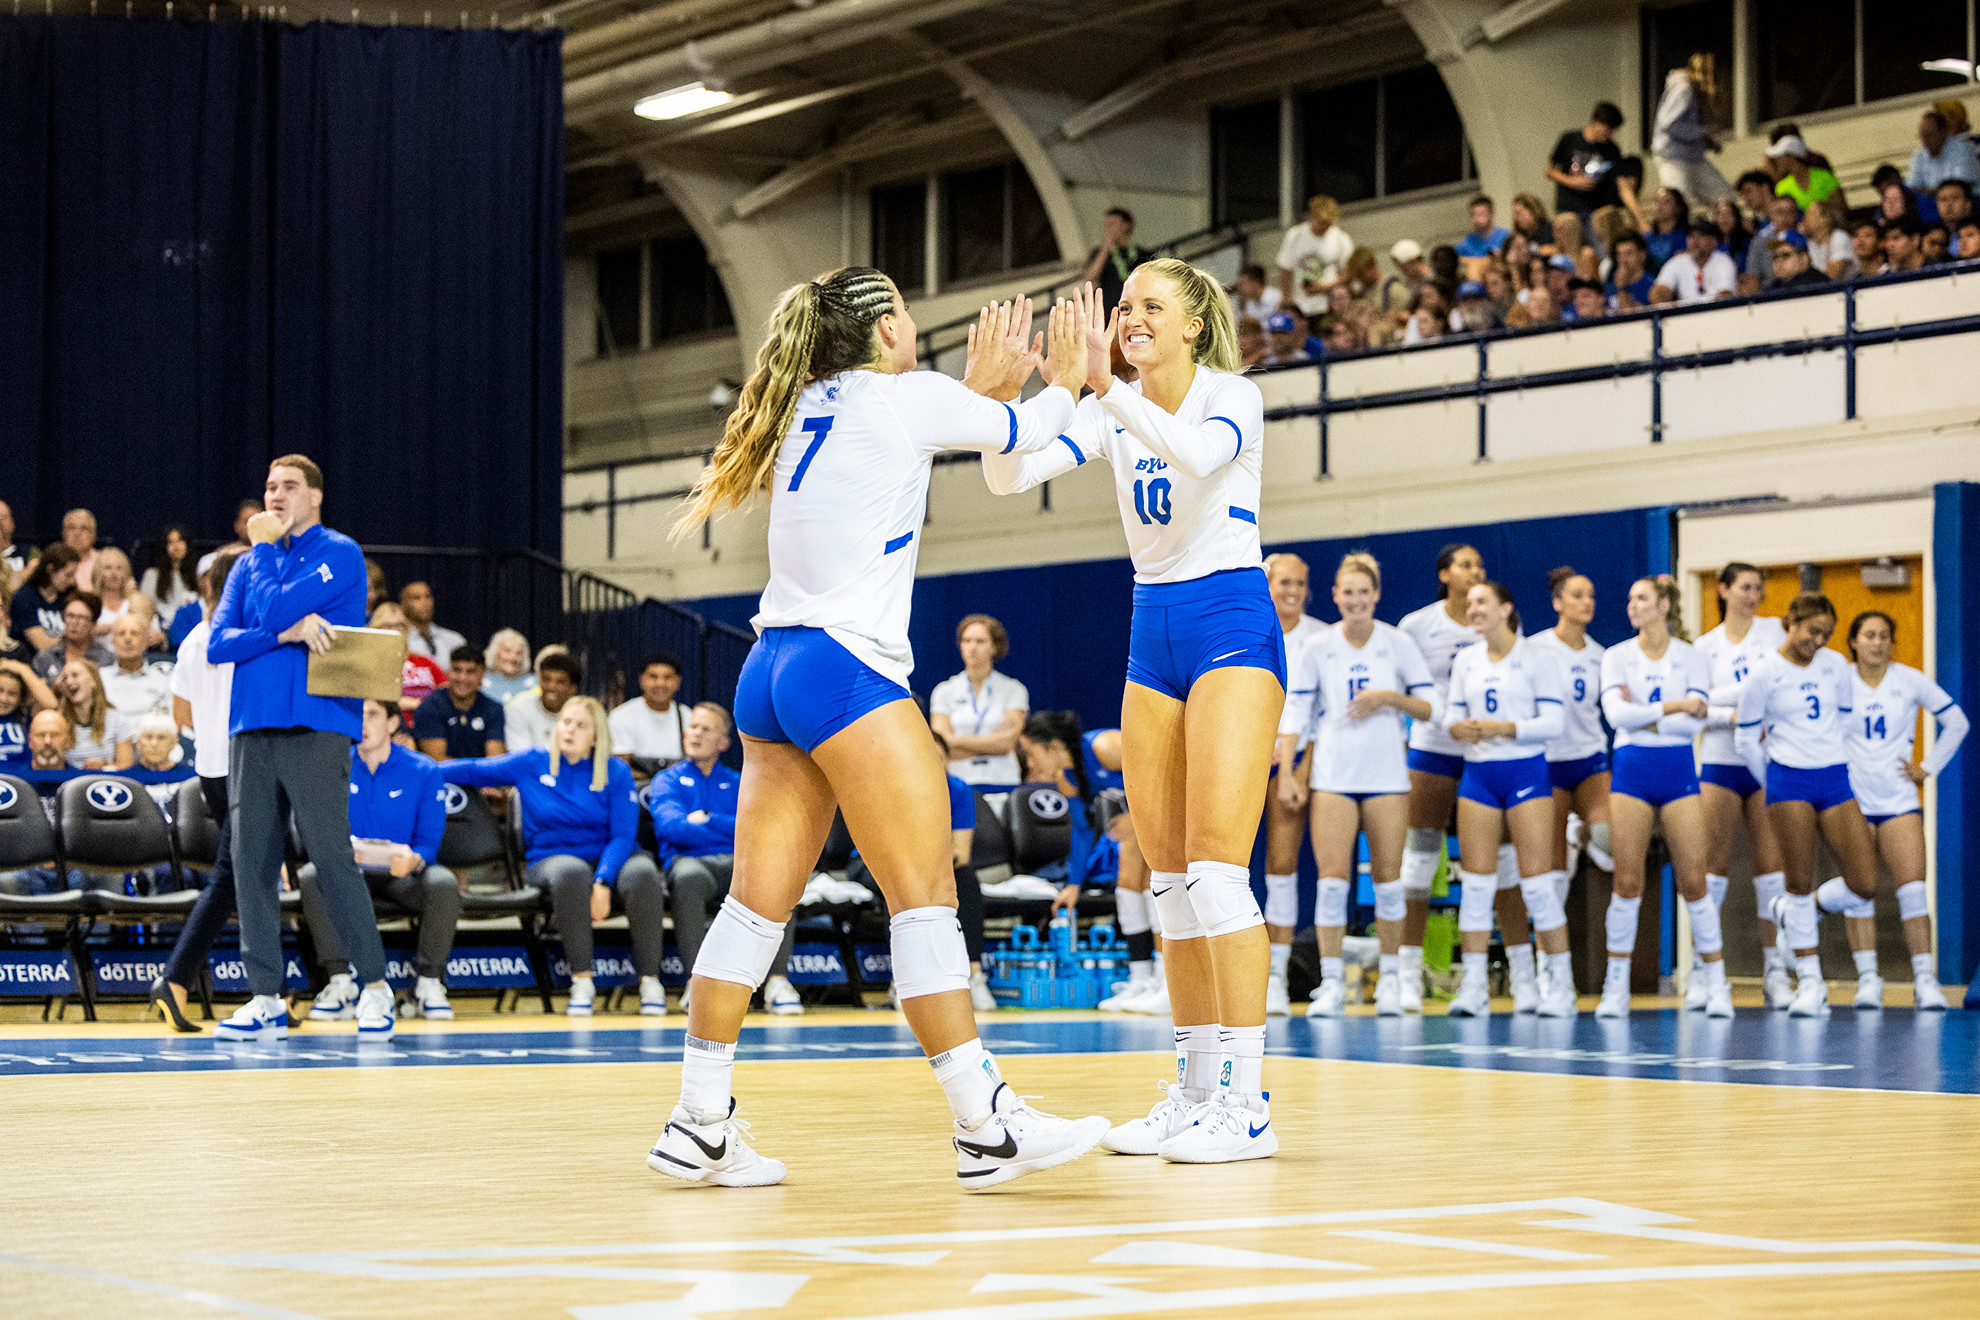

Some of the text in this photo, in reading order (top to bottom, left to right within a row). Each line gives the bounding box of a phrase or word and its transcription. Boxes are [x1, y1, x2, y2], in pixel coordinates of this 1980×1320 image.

[787, 415, 835, 491] 7
[1135, 458, 1168, 474] BYU
[1133, 478, 1172, 525] 10
[1485, 688, 1498, 713] 6
[1574, 678, 1586, 702] 9
[1806, 695, 1820, 719] 3
[1865, 715, 1887, 739] 14
